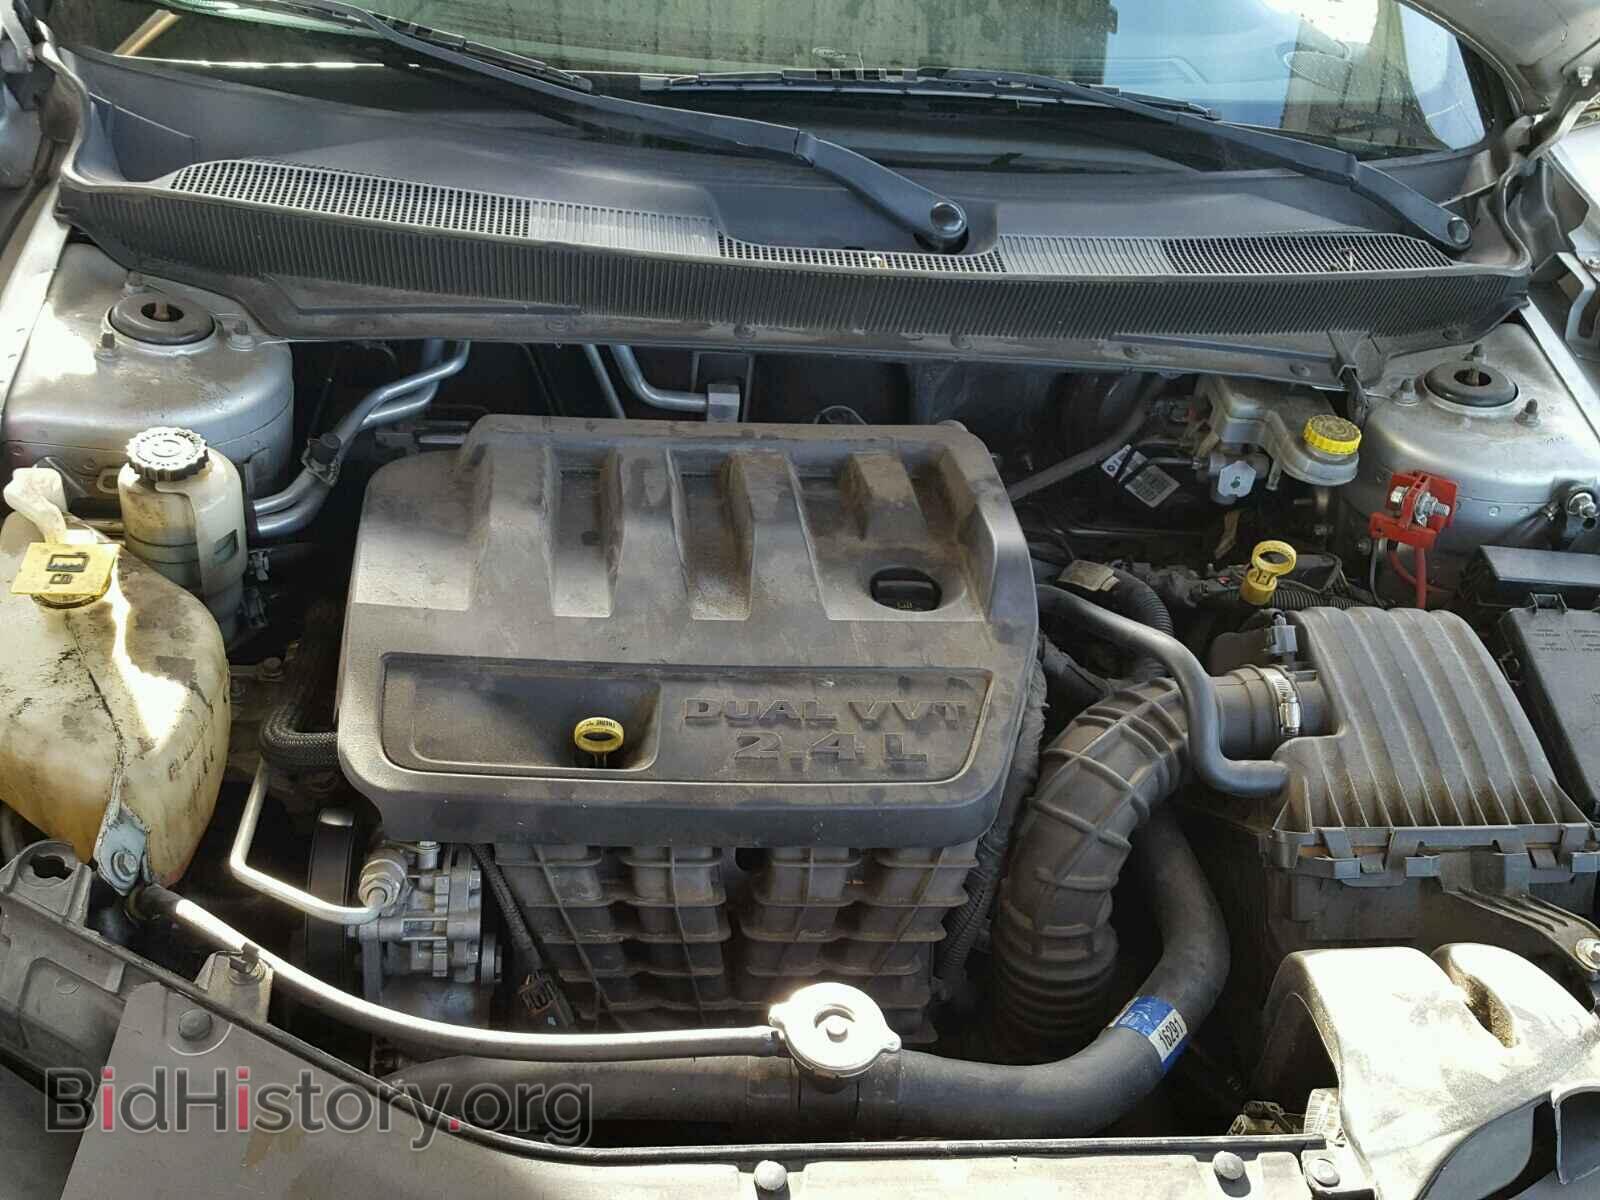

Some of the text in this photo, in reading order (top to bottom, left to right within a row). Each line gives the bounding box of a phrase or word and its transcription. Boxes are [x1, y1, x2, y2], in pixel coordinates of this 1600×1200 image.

[683, 698, 966, 726] DUAL VVT
[734, 729, 928, 764] 2.4L
[1158, 1017, 1185, 1051] 16291
